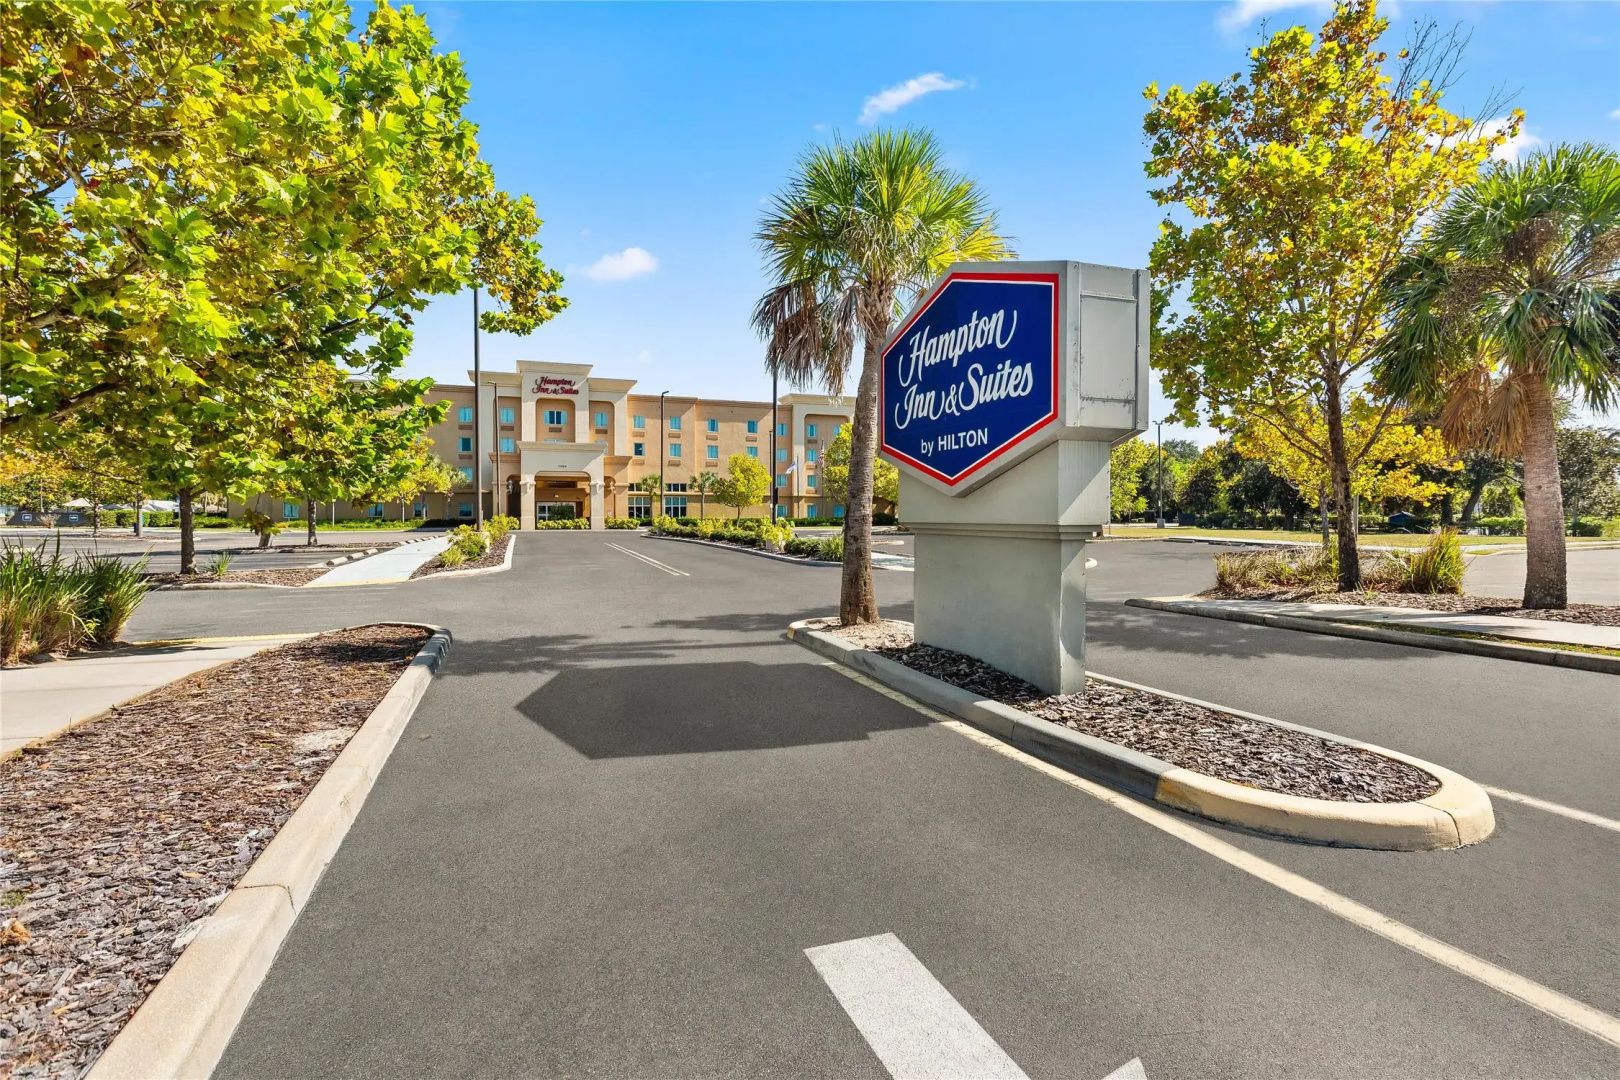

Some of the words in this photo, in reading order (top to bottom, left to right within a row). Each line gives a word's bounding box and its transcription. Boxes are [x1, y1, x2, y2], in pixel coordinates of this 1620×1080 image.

[899, 309, 1017, 387] Hampton
[895, 384, 945, 429] Inn
[945, 384, 961, 416] &
[958, 360, 1033, 411] Suites
[920, 438, 934, 457] by
[938, 428, 988, 451] HILTON
